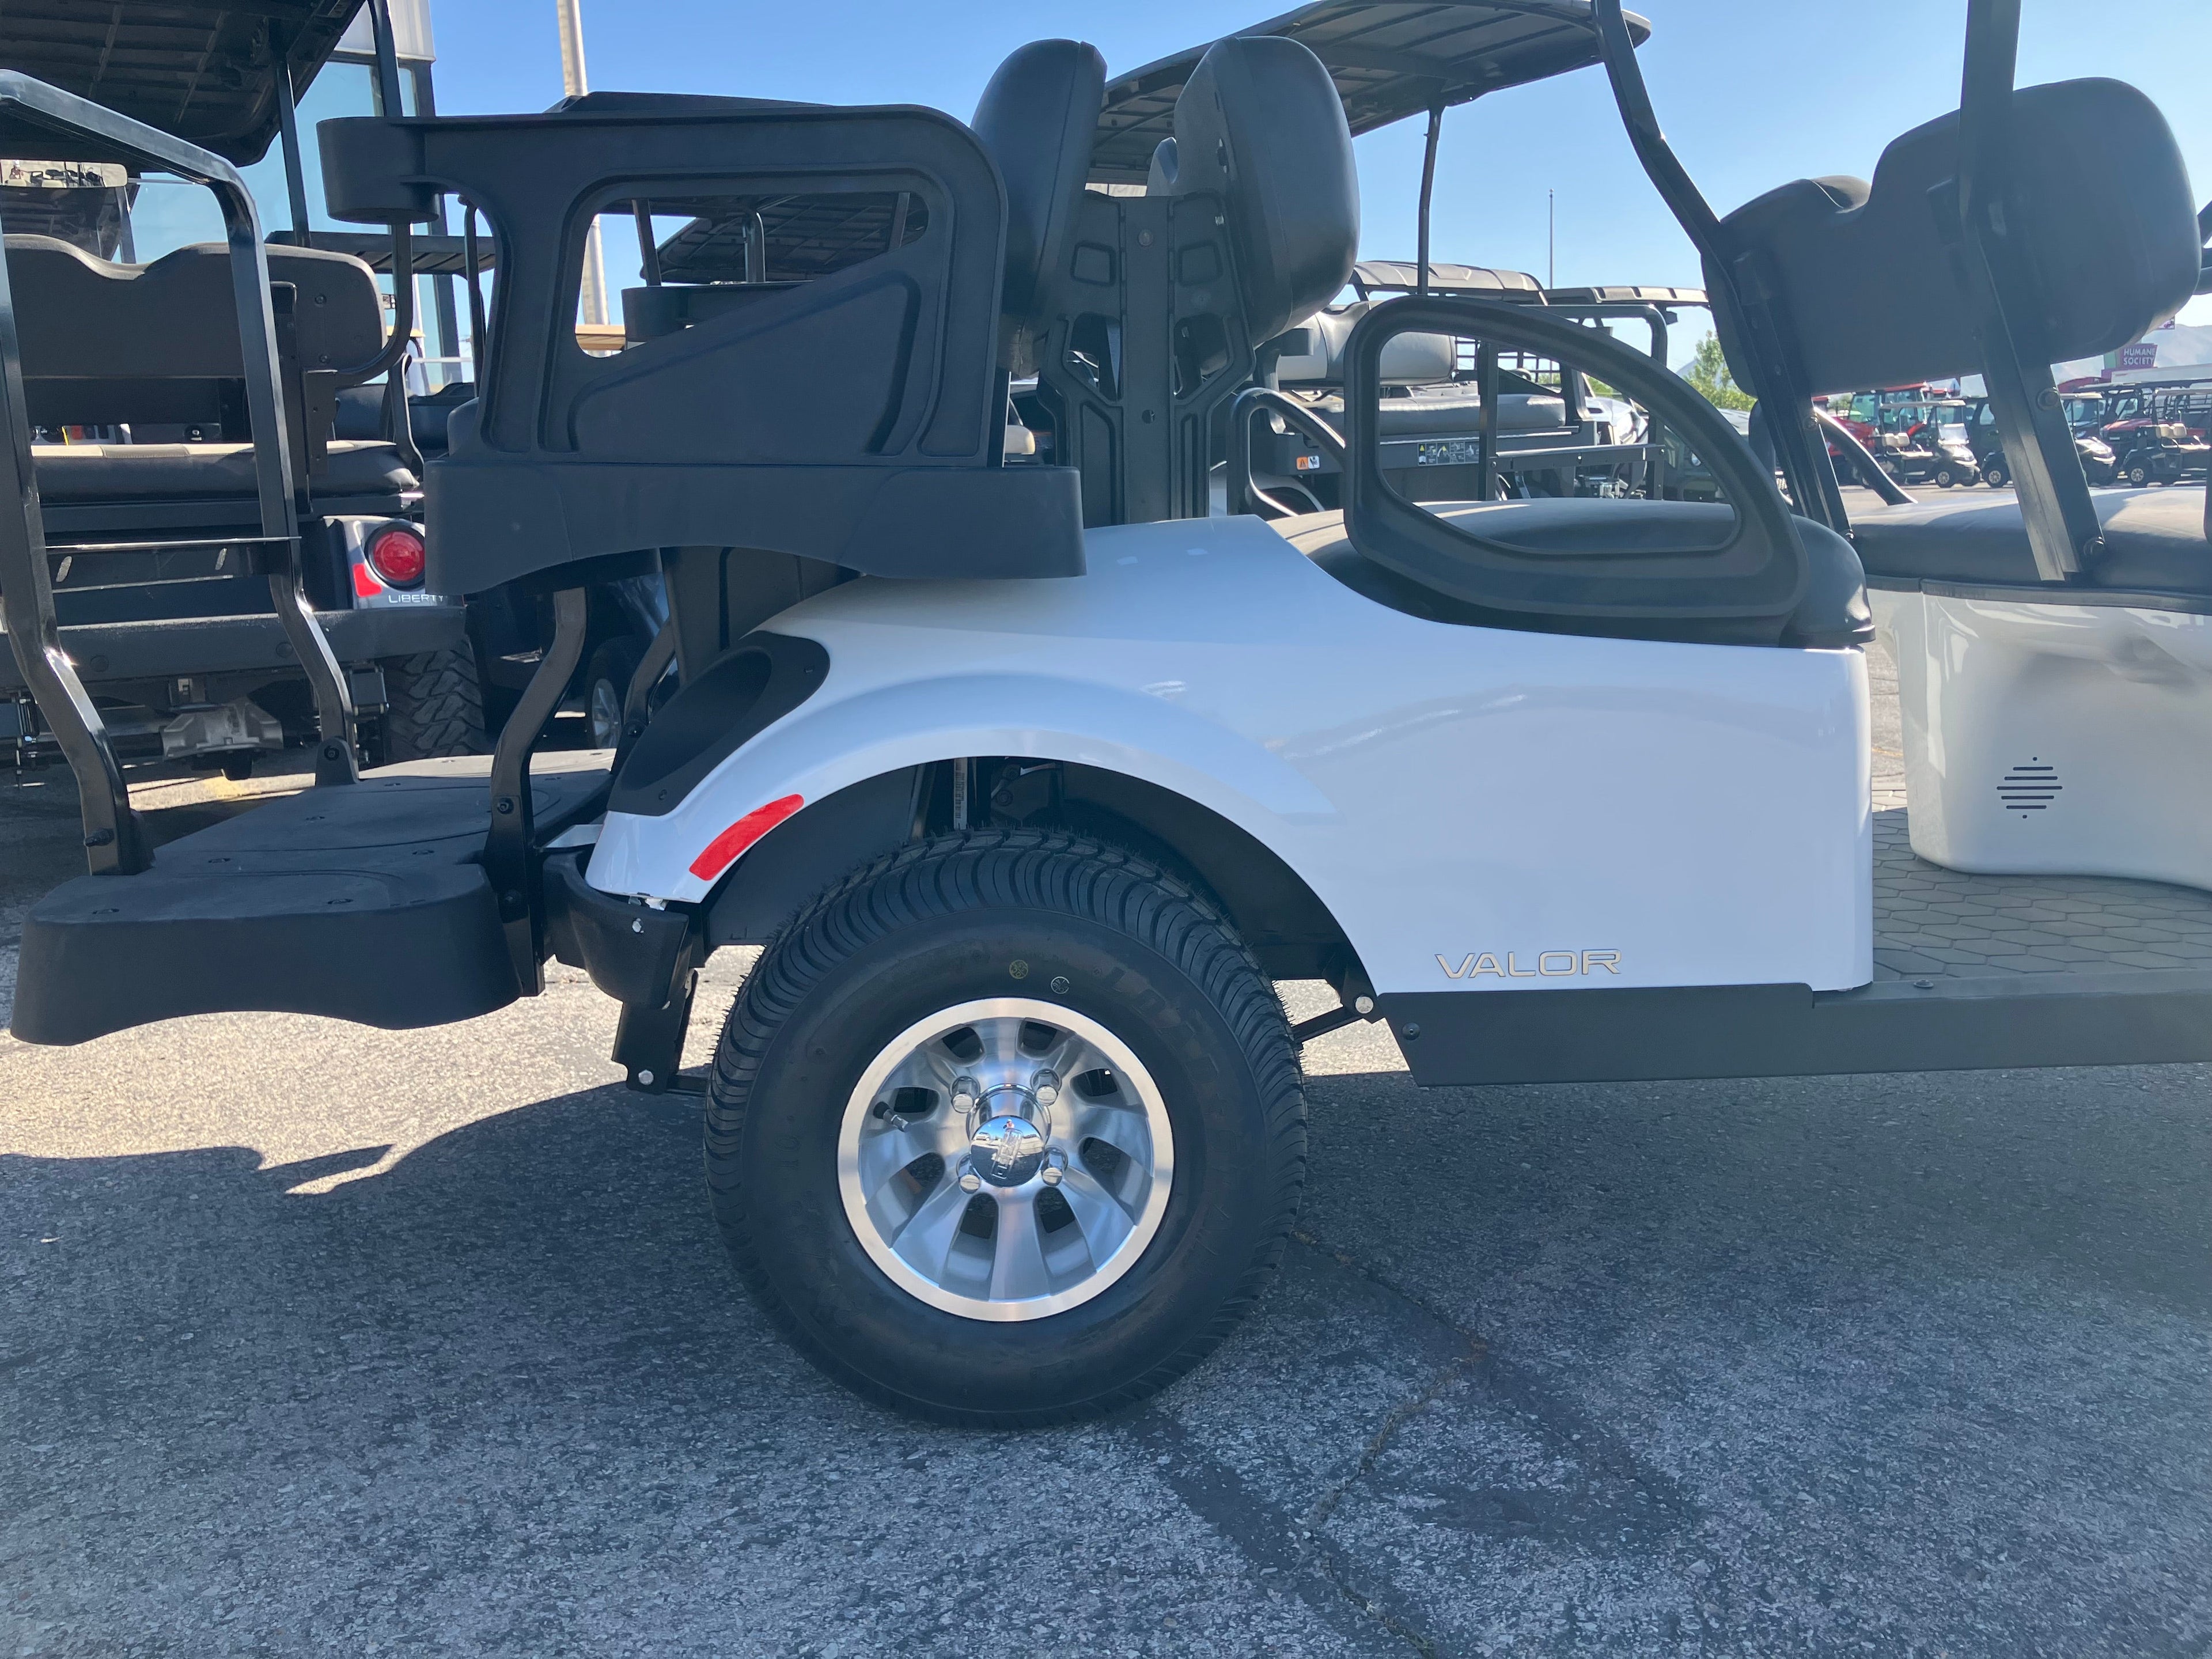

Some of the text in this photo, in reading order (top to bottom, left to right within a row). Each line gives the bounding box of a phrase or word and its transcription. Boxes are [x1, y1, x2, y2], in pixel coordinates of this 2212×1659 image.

[2124, 348, 2155, 356] HUMANE
[2123, 357, 2154, 365] SOCIETY
[388, 594, 443, 603] LIBERTY
[1434, 949, 1622, 979] VALOR
